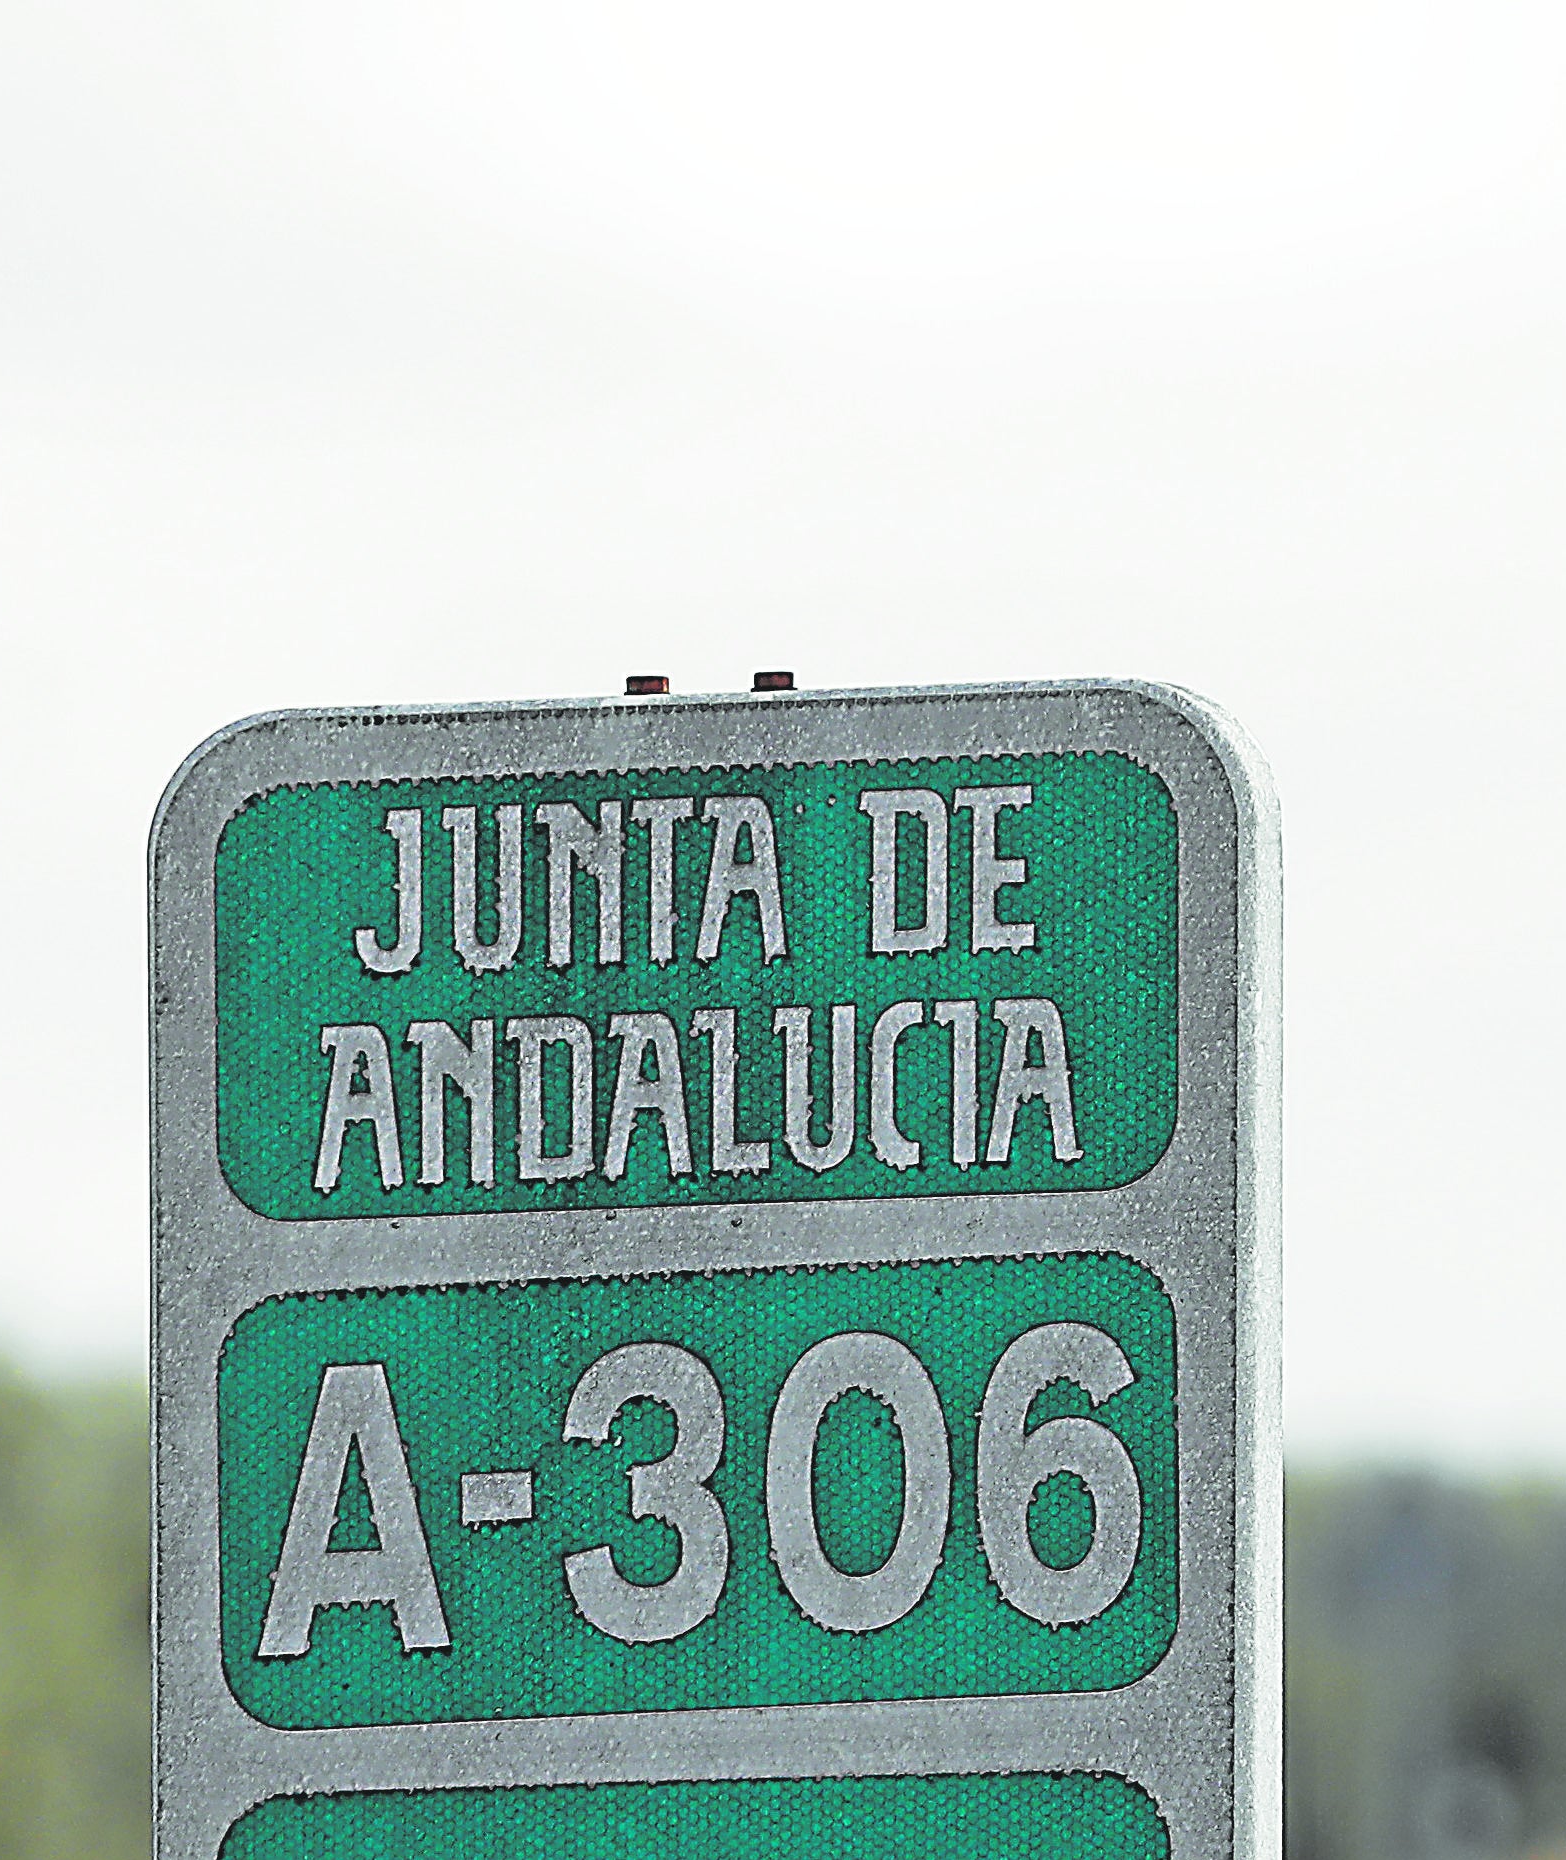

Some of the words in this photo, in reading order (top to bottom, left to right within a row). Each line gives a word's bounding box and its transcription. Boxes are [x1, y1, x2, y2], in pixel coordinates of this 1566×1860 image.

[353, 793, 787, 976] JUNTA
[859, 783, 1037, 957] DE
[314, 997, 1084, 1194] ANDALUCIA
[257, 1321, 1143, 1658] A-306
